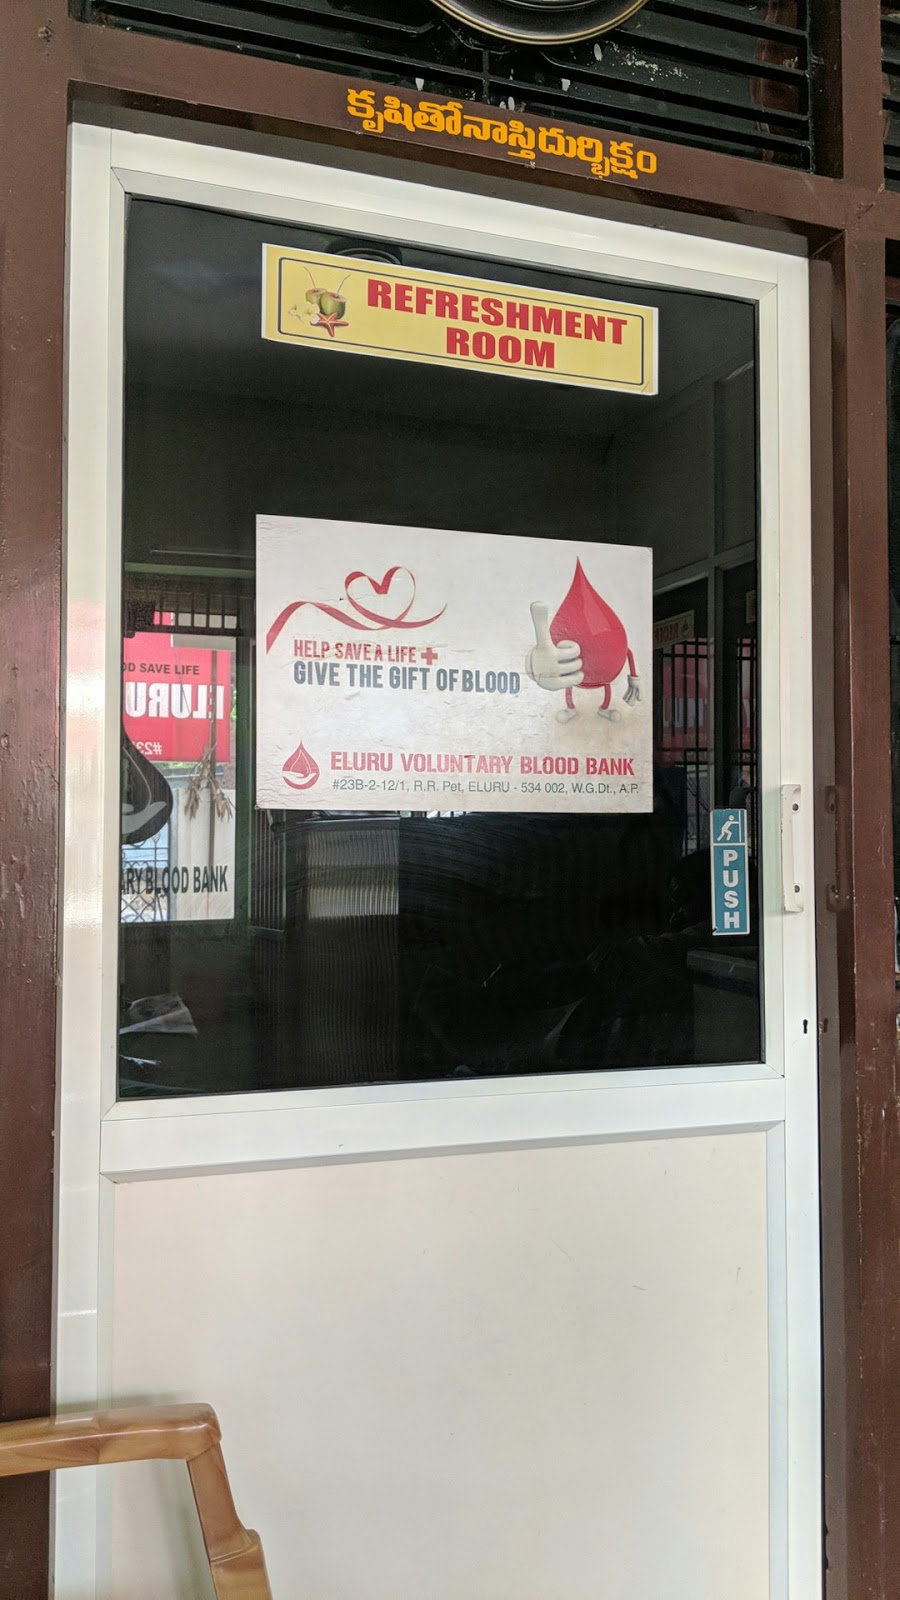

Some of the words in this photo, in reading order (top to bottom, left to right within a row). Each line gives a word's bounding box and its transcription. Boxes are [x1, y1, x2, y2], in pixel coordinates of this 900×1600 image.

[367, 278, 628, 345] REFRESHMENT
[446, 327, 556, 369] ROOM
[293, 639, 330, 661] HELP
[334, 642, 374, 662] SAVE
[374, 645, 384, 662] A
[387, 646, 417, 664] LIFE
[139, 662, 171, 674] SAVE
[174, 664, 200, 676] LIFE
[293, 660, 340, 687] GIVE
[346, 663, 383, 689] THE
[388, 665, 430, 691] GIFT
[436, 667, 459, 692] OF
[462, 668, 521, 694] BLOOD
[330, 751, 393, 772] ELURU
[400, 752, 514, 776] VOLUNTARY
[520, 755, 580, 776] BLOOD
[585, 756, 635, 777] BANK
[332, 778, 410, 793] #23B-2-12/1,
[413, 780, 440, 793] R.R.
[442, 780, 465, 795] Pet,
[468, 781, 511, 793] ELURU
[520, 783, 541, 794] 534
[543, 783, 568, 796] 002,
[571, 783, 616, 797] W.G.Dt.,
[619, 784, 640, 794] A.P.
[145, 865, 190, 895] BLOOD
[193, 864, 229, 893] BANK
[722, 849, 741, 929] PUSH
